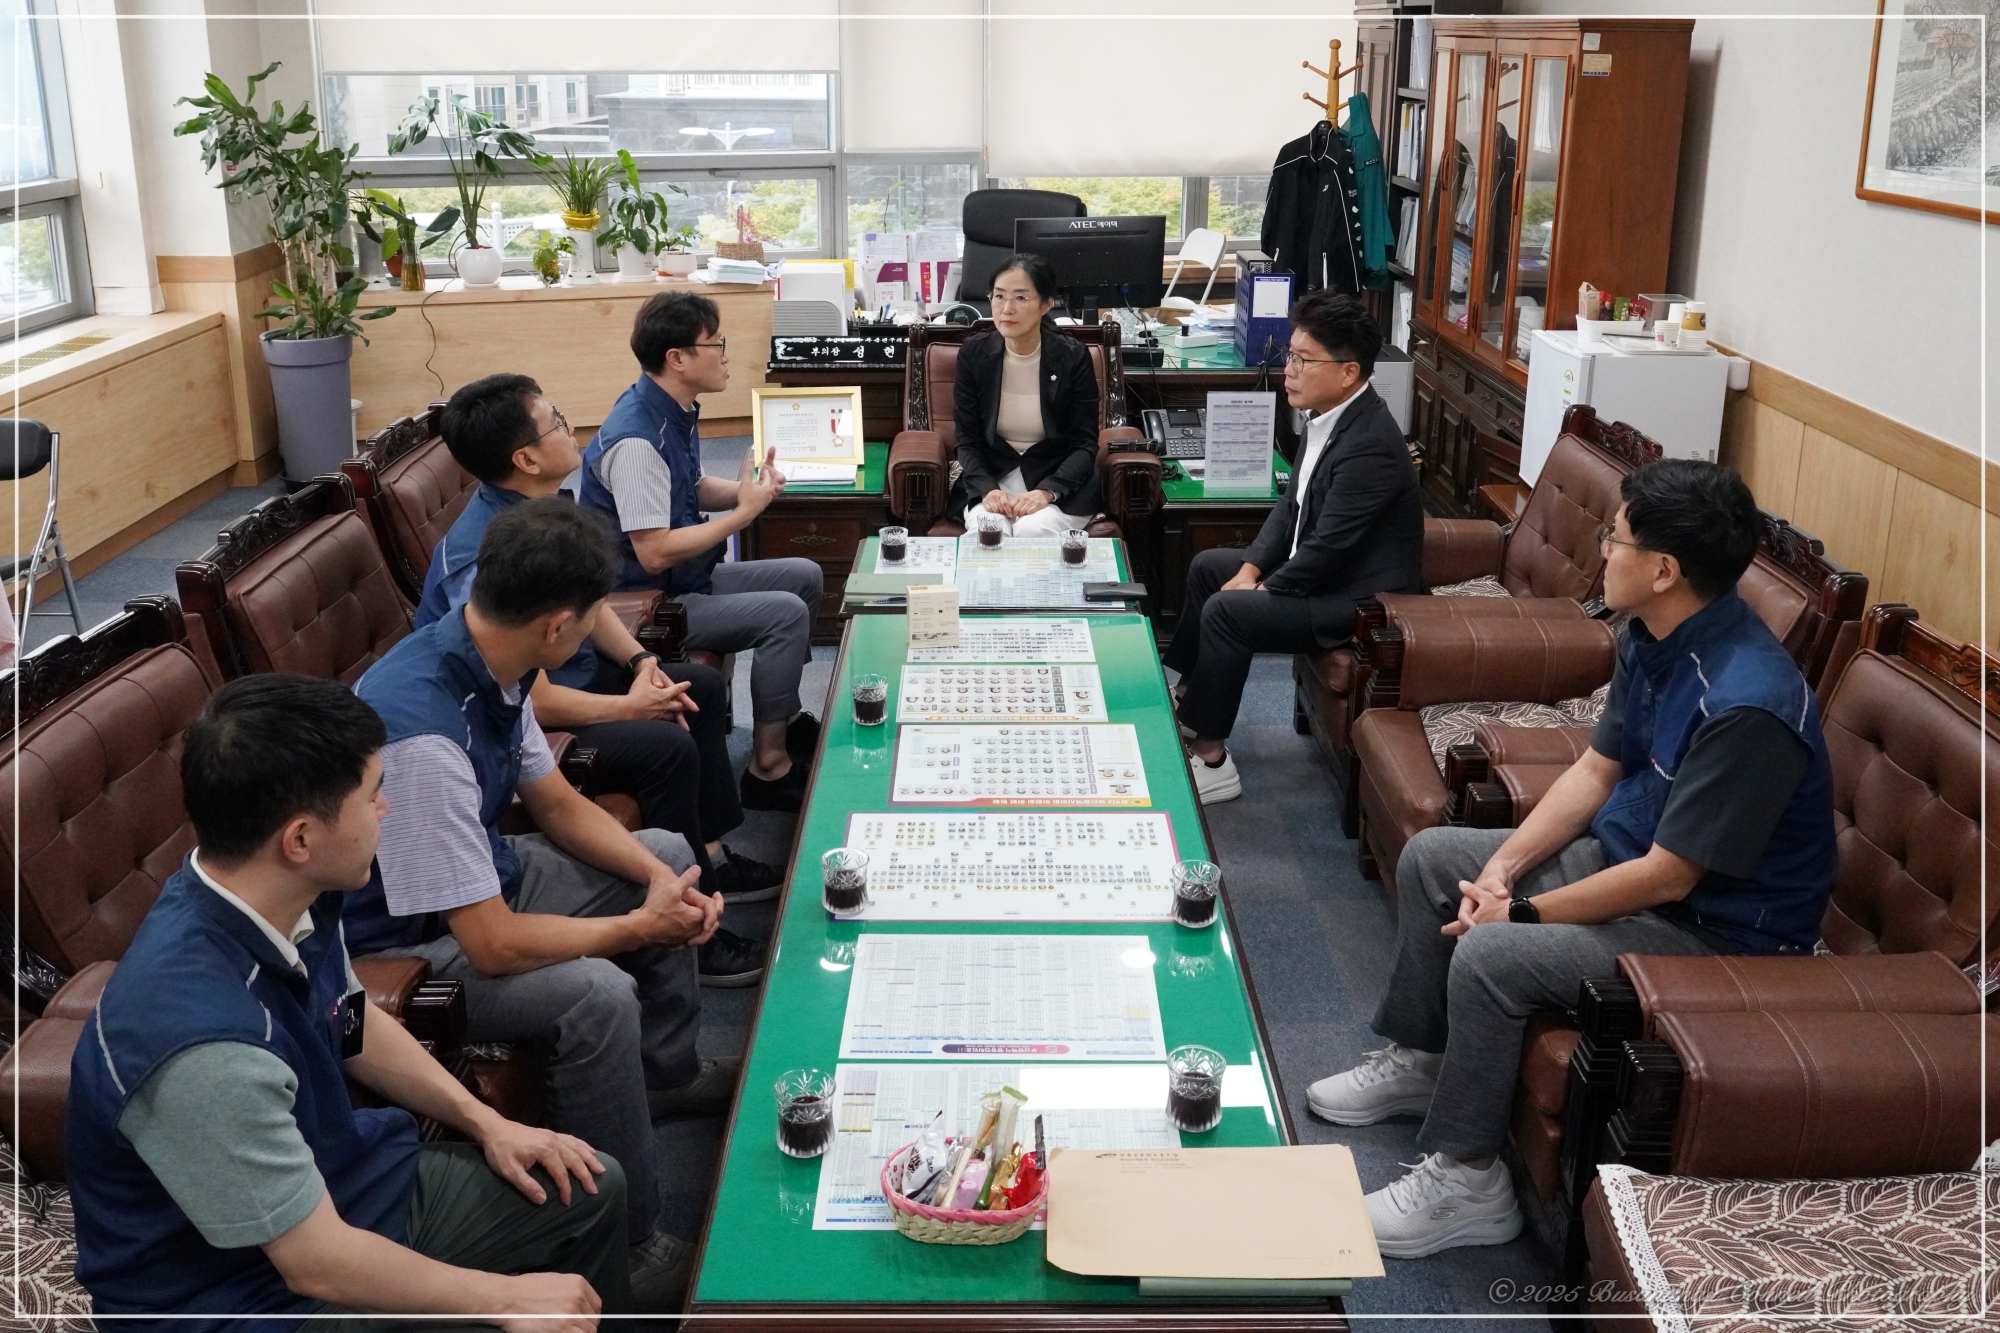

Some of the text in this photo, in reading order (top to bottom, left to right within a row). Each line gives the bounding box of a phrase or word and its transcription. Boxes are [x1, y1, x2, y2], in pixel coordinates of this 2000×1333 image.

[811, 345, 896, 359] 부의장 성 현
